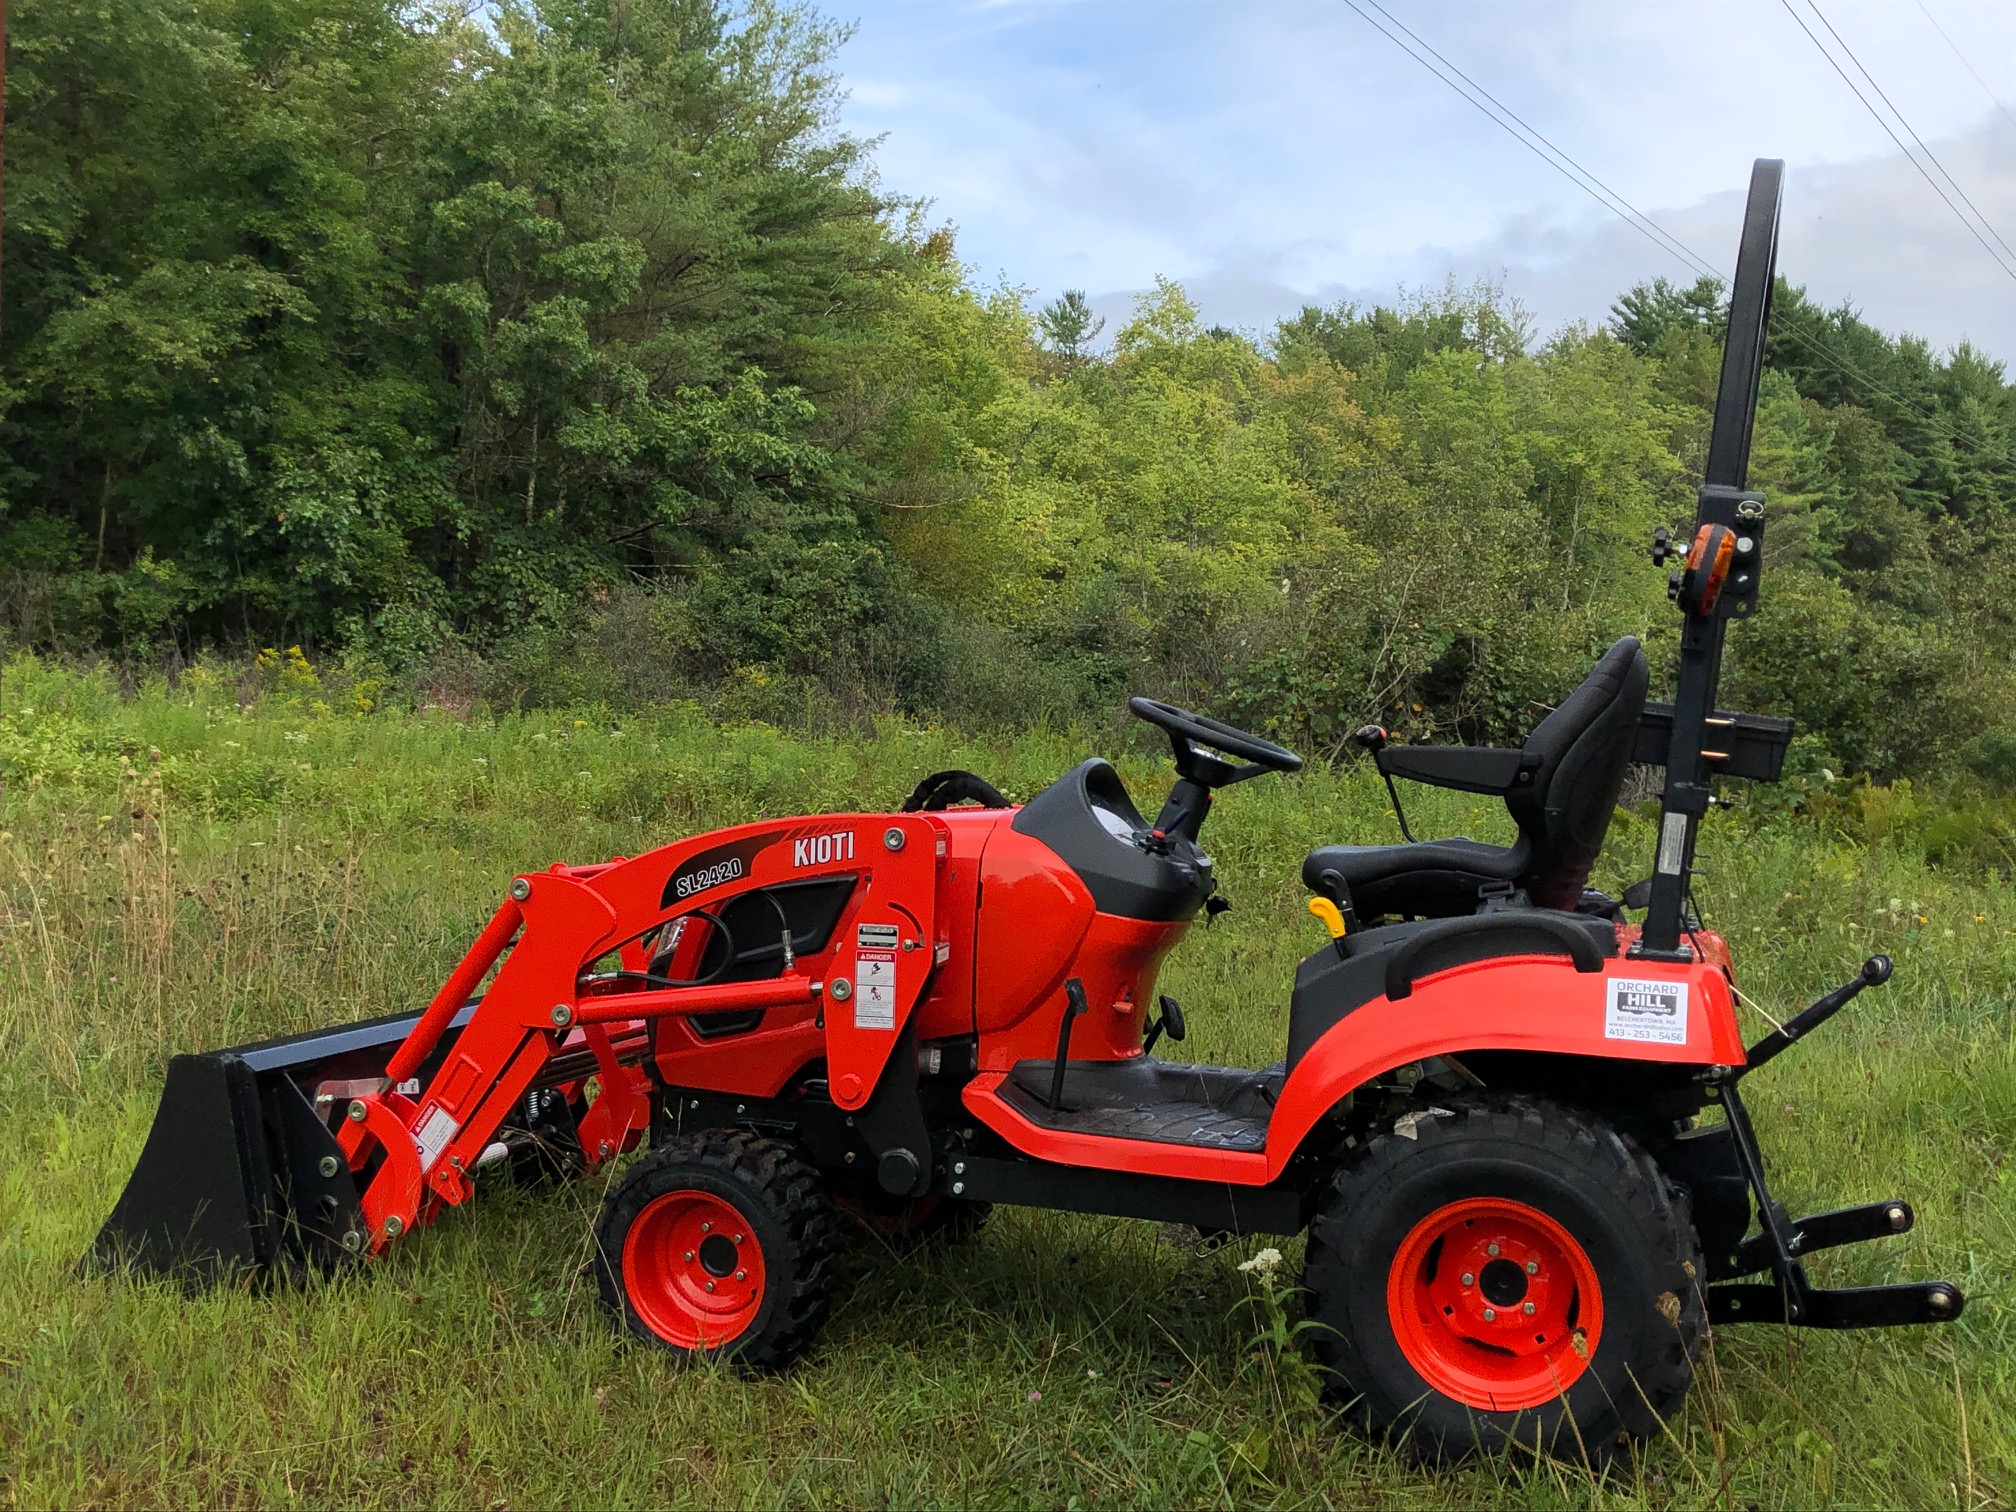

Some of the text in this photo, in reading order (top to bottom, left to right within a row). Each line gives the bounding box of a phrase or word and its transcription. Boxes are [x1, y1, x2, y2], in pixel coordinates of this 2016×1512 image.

[793, 831, 854, 868] KIOTI
[676, 857, 743, 897] SL2420
[1617, 981, 1679, 994] ORCHARD
[1627, 993, 1666, 1008] HILL
[1609, 1028, 1625, 1036] 413
[1633, 1030, 1650, 1038] 253
[1658, 1032, 1683, 1041] 5456
